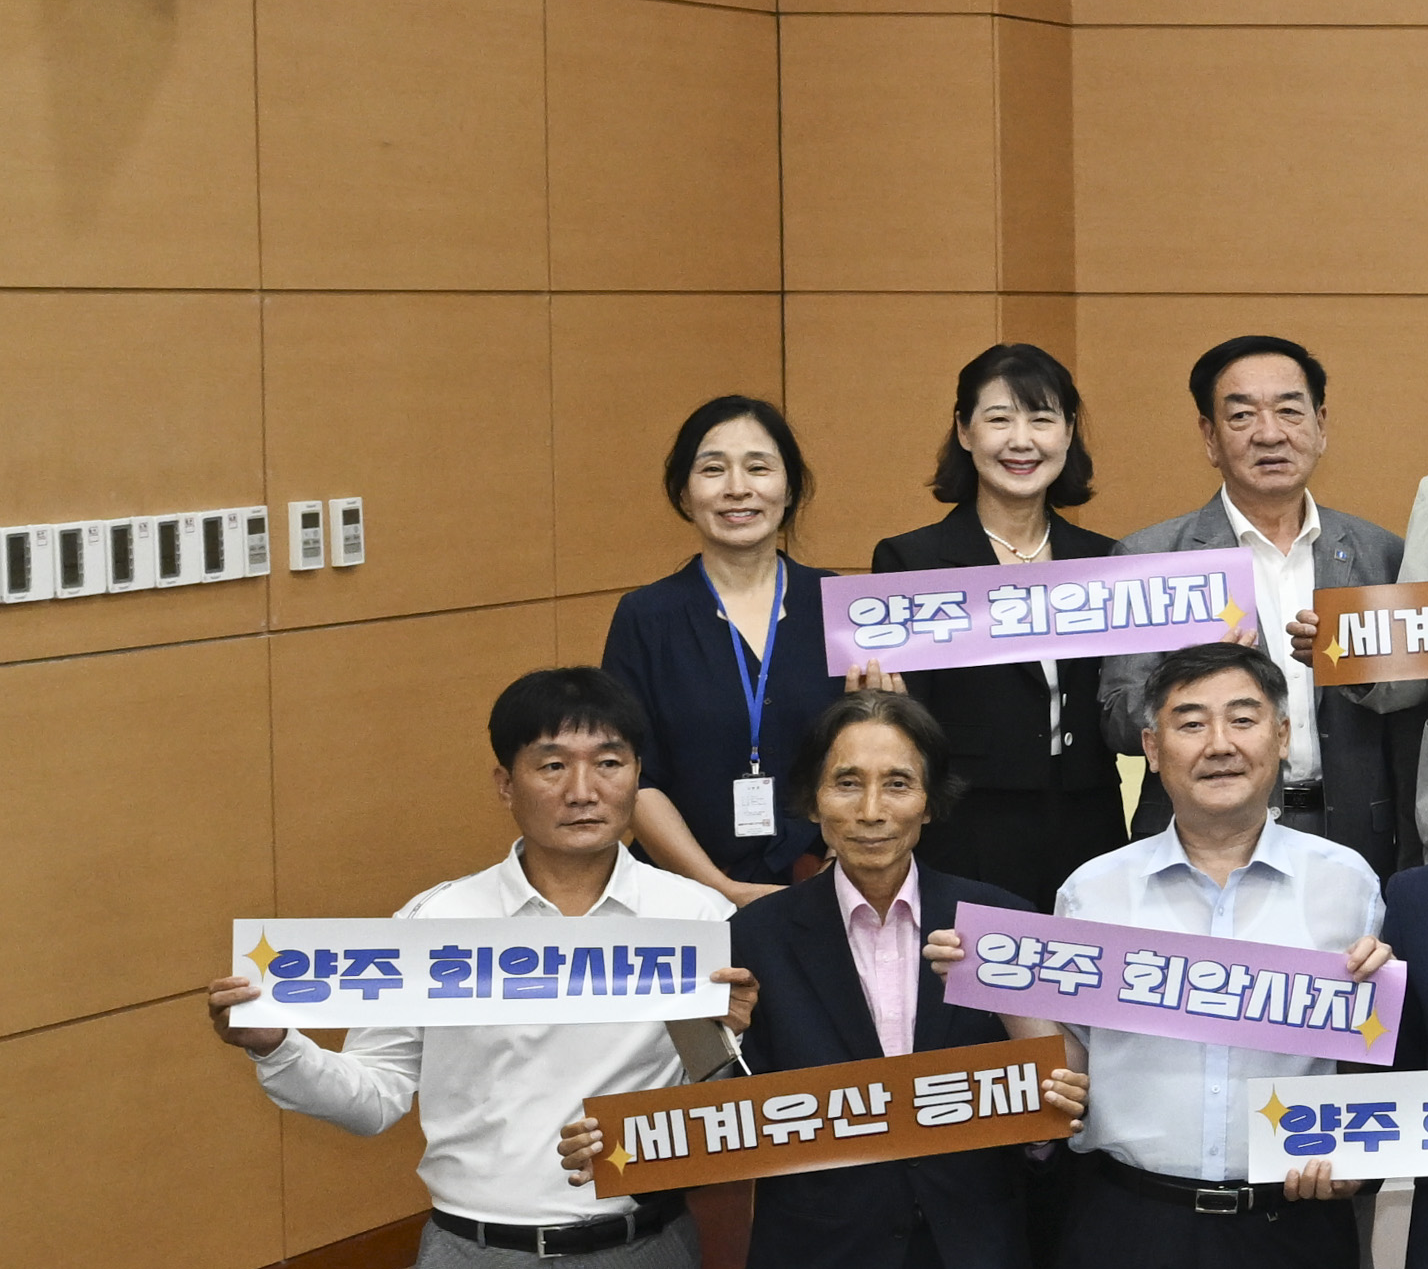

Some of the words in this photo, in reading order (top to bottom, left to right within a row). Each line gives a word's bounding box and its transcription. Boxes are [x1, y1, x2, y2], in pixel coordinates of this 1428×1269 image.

[847, 591, 970, 650] 양주
[987, 571, 1230, 640] 회암사지
[266, 946, 404, 1004] 양주
[427, 944, 698, 1000] 회암사지
[974, 931, 1105, 998] 양주
[1119, 946, 1379, 1037] 회암사지
[622, 1081, 893, 1163] 세계유산
[912, 1062, 1043, 1128] 등재
[1278, 1097, 1400, 1158] 양주
